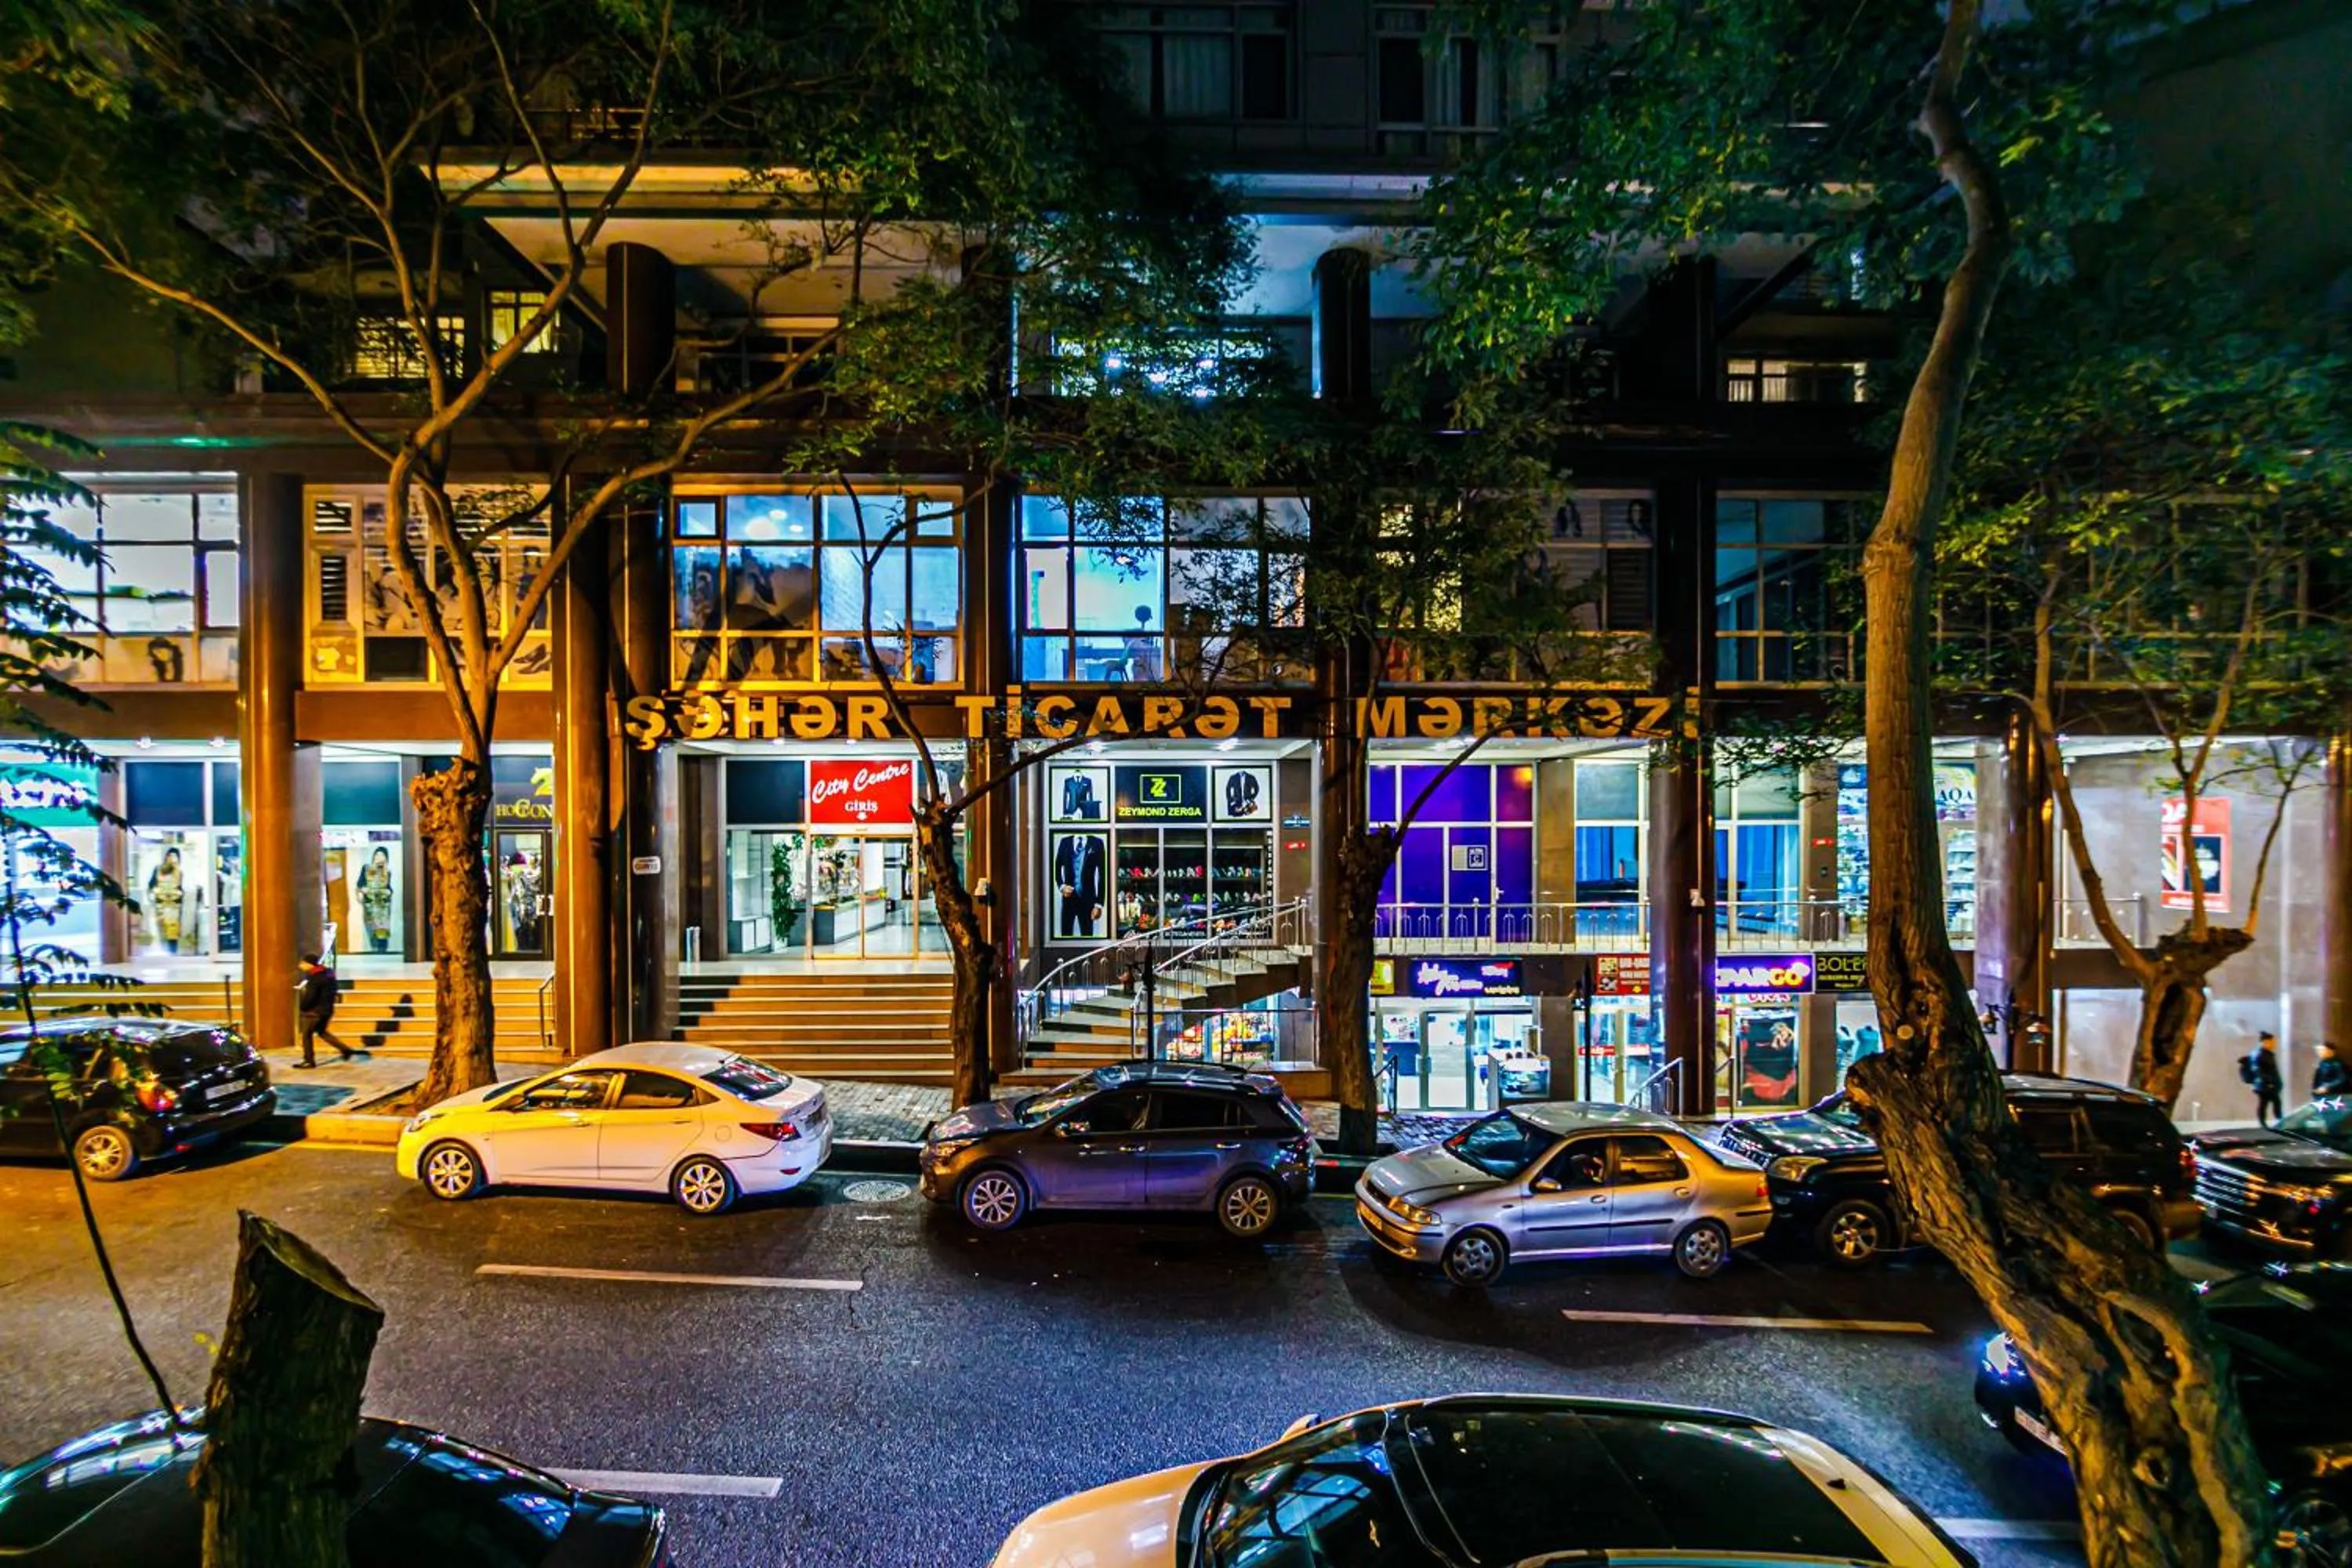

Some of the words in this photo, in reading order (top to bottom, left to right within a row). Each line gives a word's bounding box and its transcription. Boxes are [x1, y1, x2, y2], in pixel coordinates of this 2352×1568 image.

[625, 695, 892, 750] ŞƏHƏR
[954, 684, 1292, 739] TİCARƏT
[811, 777, 849, 804] City
[853, 763, 910, 791] Centre
[1118, 807, 1166, 816] ZEYMOND
[1167, 807, 1202, 816] ZERGA
